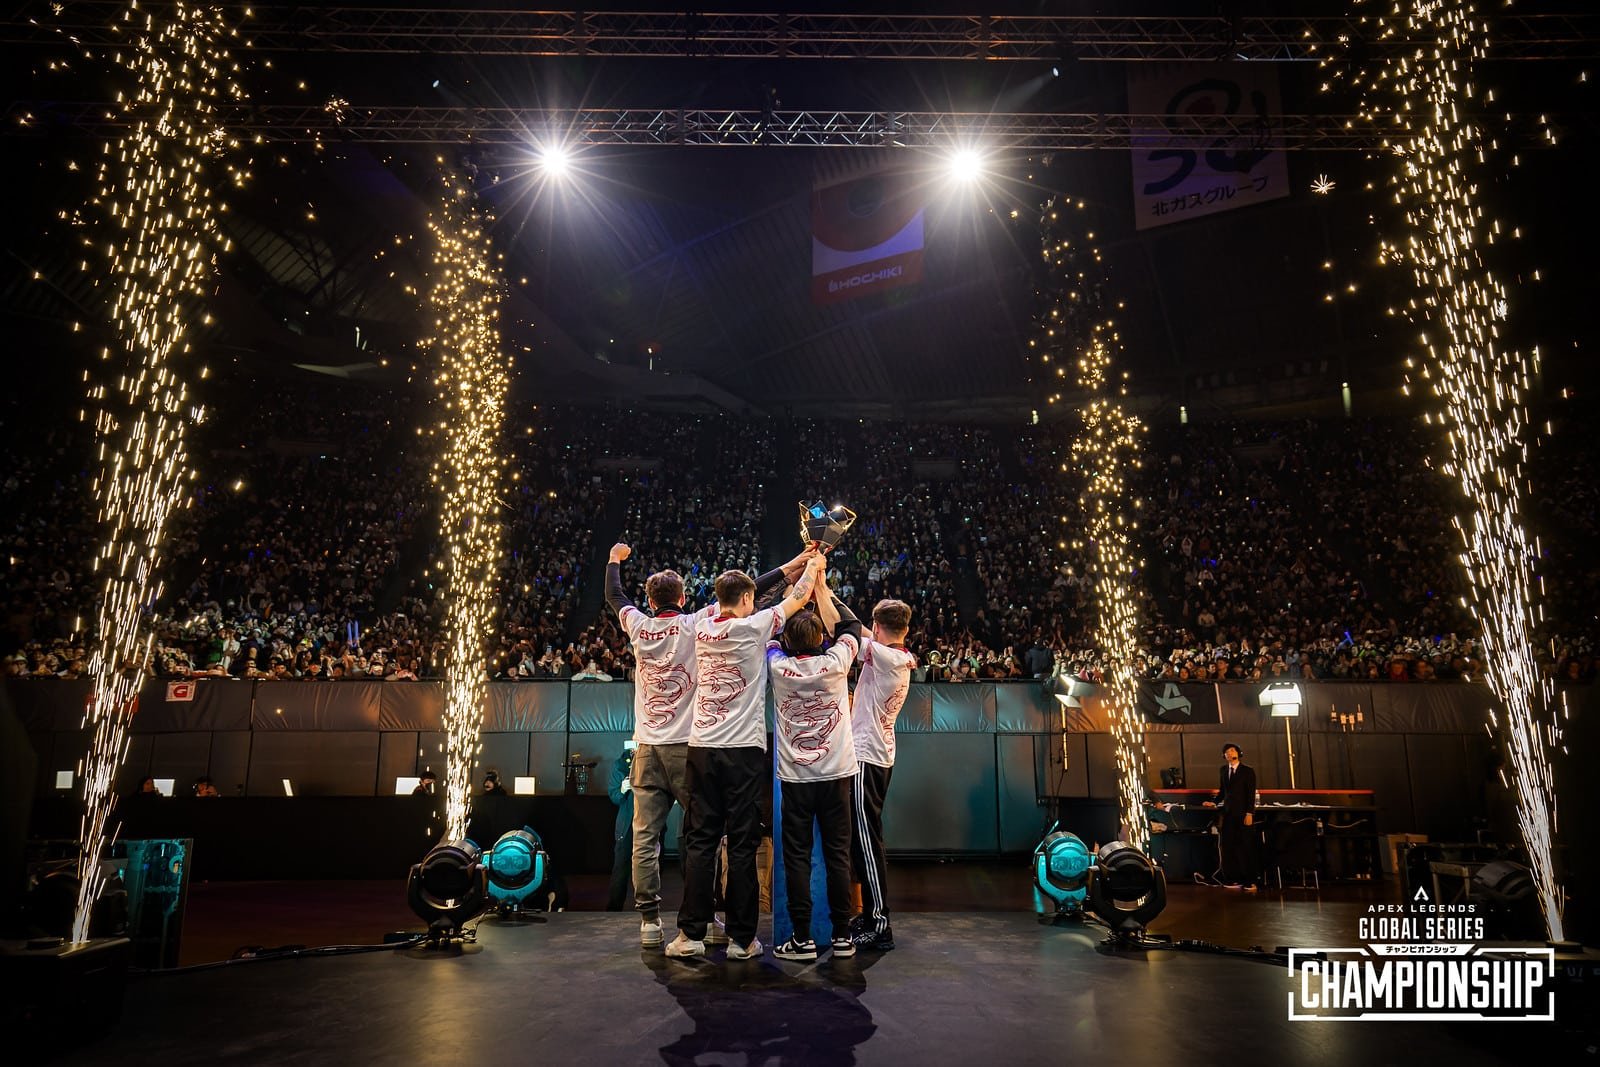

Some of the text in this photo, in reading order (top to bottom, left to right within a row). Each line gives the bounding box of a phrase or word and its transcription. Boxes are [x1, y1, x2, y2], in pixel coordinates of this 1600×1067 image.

[1152, 176, 1268, 216] 北ガスグループ
[839, 265, 902, 289] HOCHIKI
[640, 625, 679, 641] ESTEE
